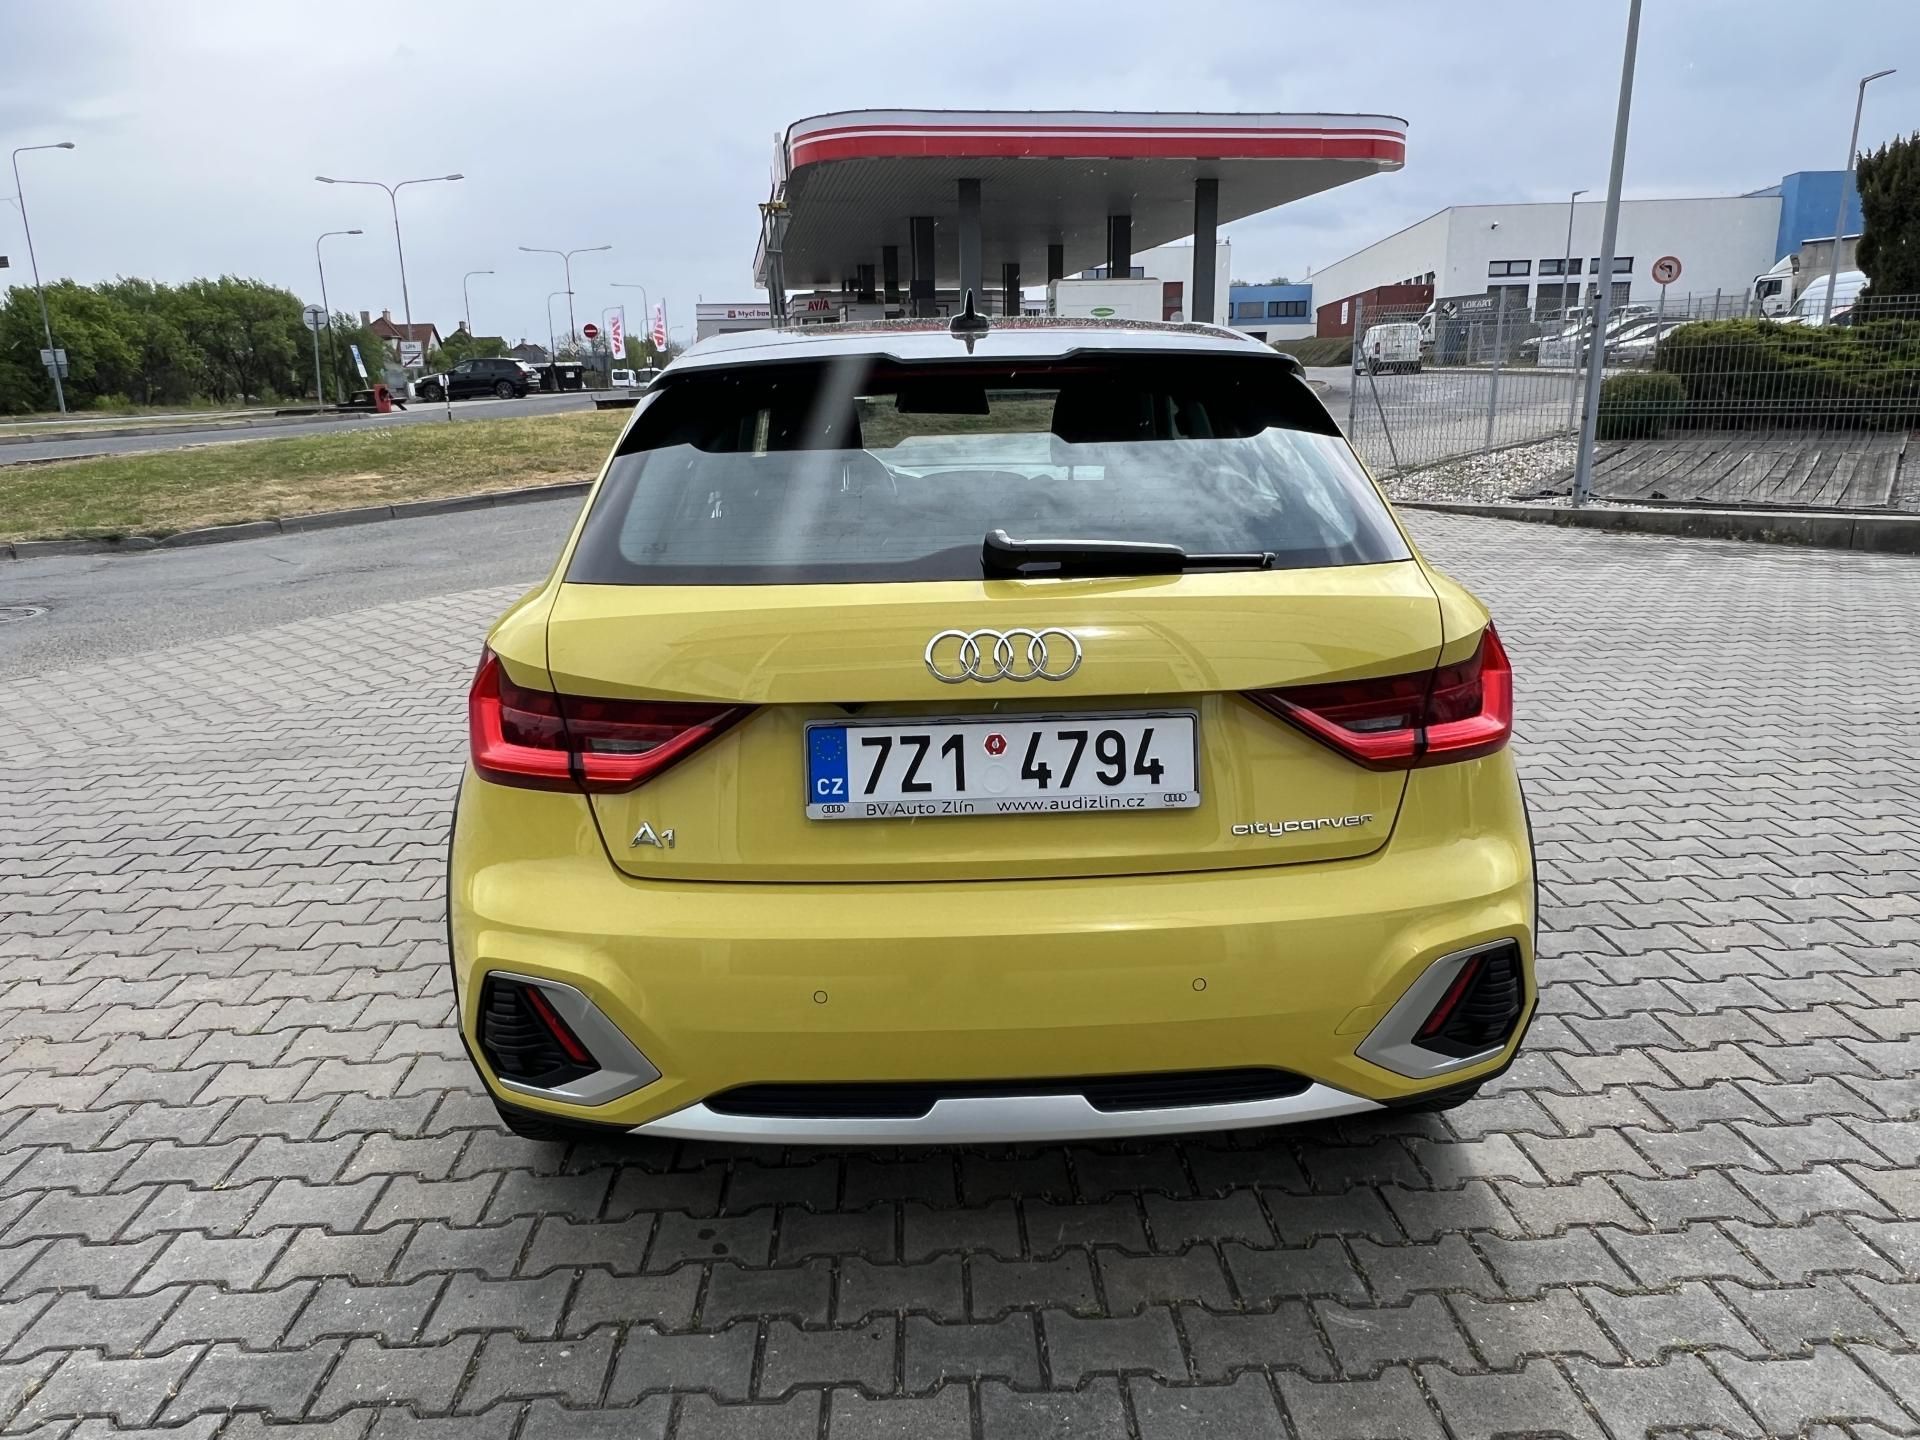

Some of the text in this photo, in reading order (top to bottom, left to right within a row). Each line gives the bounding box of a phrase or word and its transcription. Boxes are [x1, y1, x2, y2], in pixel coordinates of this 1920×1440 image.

[808, 298, 830, 311] AVIA
[1462, 300, 1492, 309] LOKART
[861, 728, 1165, 795] 7Z1 4794
[817, 778, 844, 795] CZ
[866, 801, 974, 816] BV Auto Zlín
[997, 796, 1145, 811] www.audizlin.cz
[1231, 813, 1373, 837] citycarver
[630, 822, 675, 848] A1
